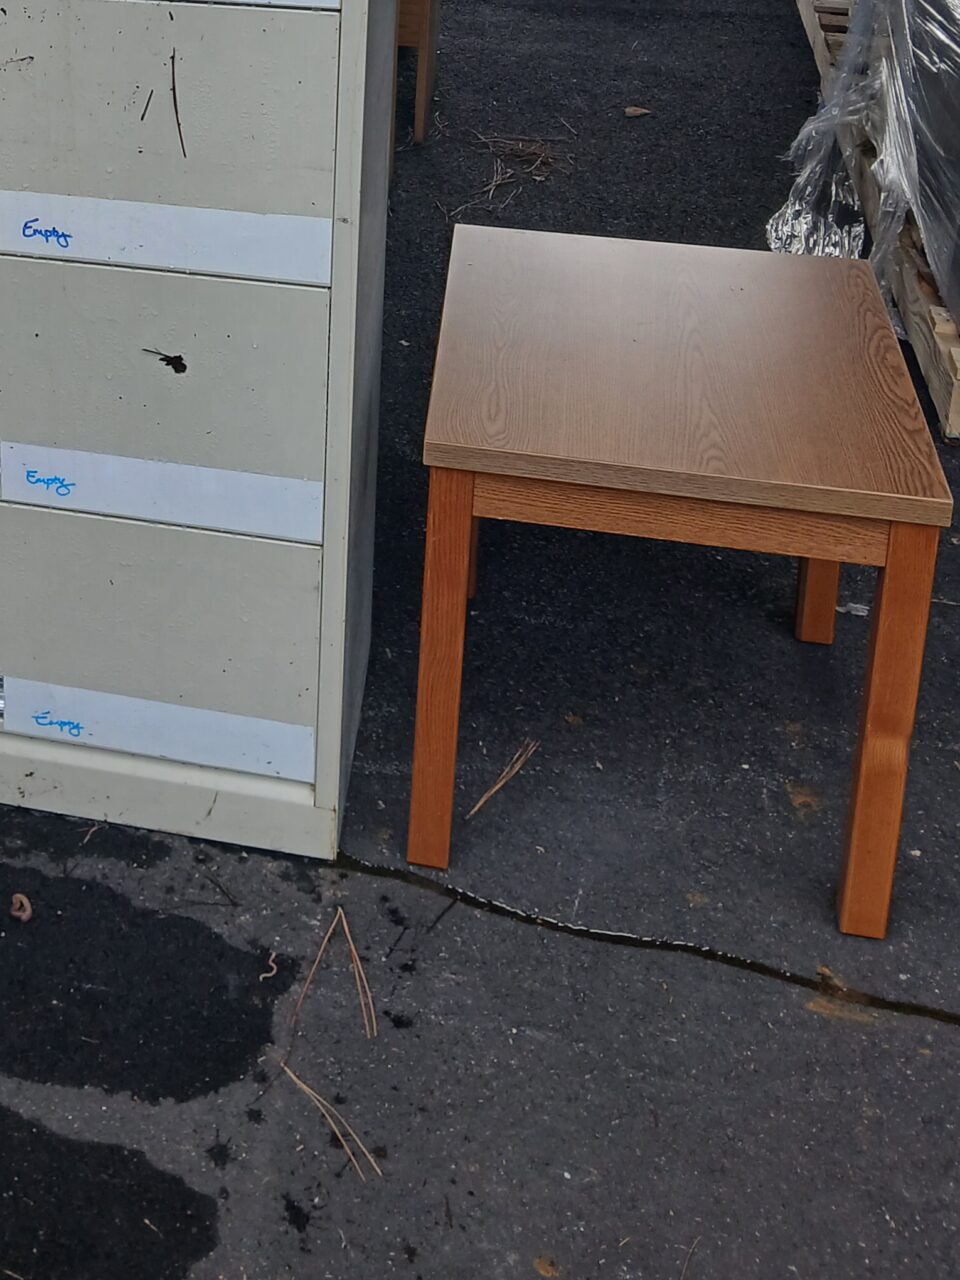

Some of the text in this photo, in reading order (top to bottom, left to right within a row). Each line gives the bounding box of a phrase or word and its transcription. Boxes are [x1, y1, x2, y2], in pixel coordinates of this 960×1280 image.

[22, 218, 72, 248] Empty
[26, 470, 76, 497] Empty
[32, 711, 84, 737] Empty
